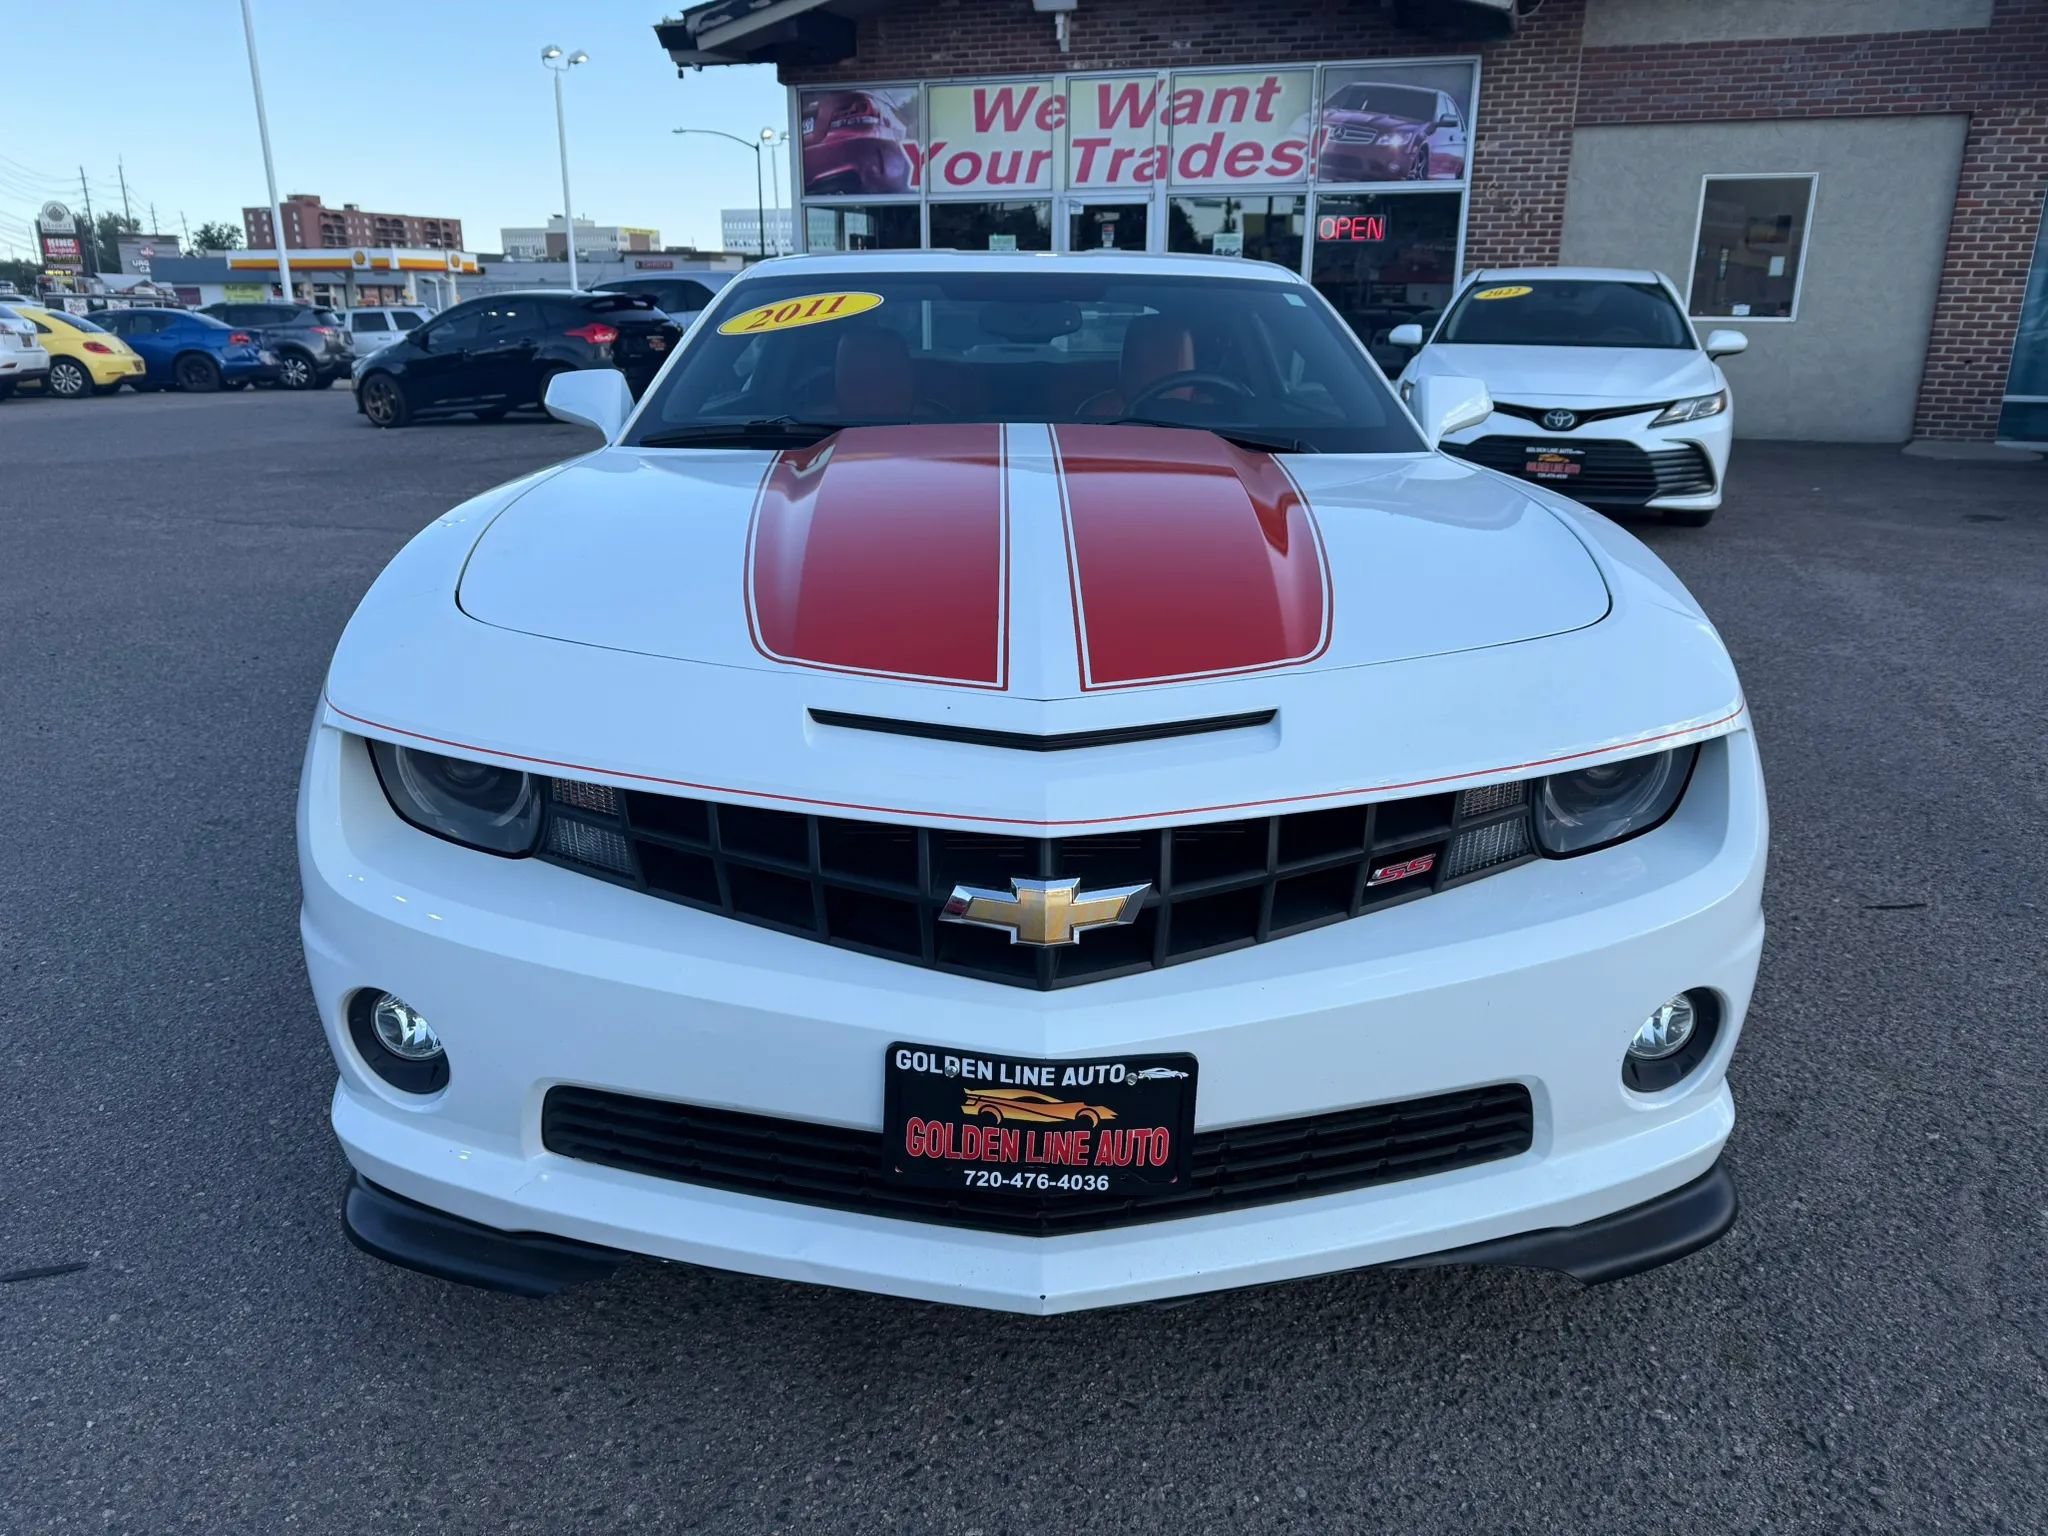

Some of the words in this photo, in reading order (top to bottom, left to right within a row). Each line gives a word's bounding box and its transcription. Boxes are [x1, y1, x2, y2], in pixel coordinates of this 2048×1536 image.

[973, 86, 1067, 133] We
[1097, 76, 1282, 129] Want
[903, 141, 1053, 186] Your
[1072, 127, 1329, 184] Trades!
[1319, 215, 1384, 241] OPEN
[744, 295, 848, 330] 2011
[1366, 852, 1437, 887] SS
[895, 1049, 993, 1081] GOLDEN
[1000, 1063, 1056, 1087] LINE
[1061, 1063, 1126, 1087] AUTO
[905, 1116, 1020, 1164] GOLDEN
[1025, 1130, 1091, 1166] LINE
[1094, 1126, 1170, 1167] AUTO
[963, 1169, 1110, 1191] 720-476-4036
